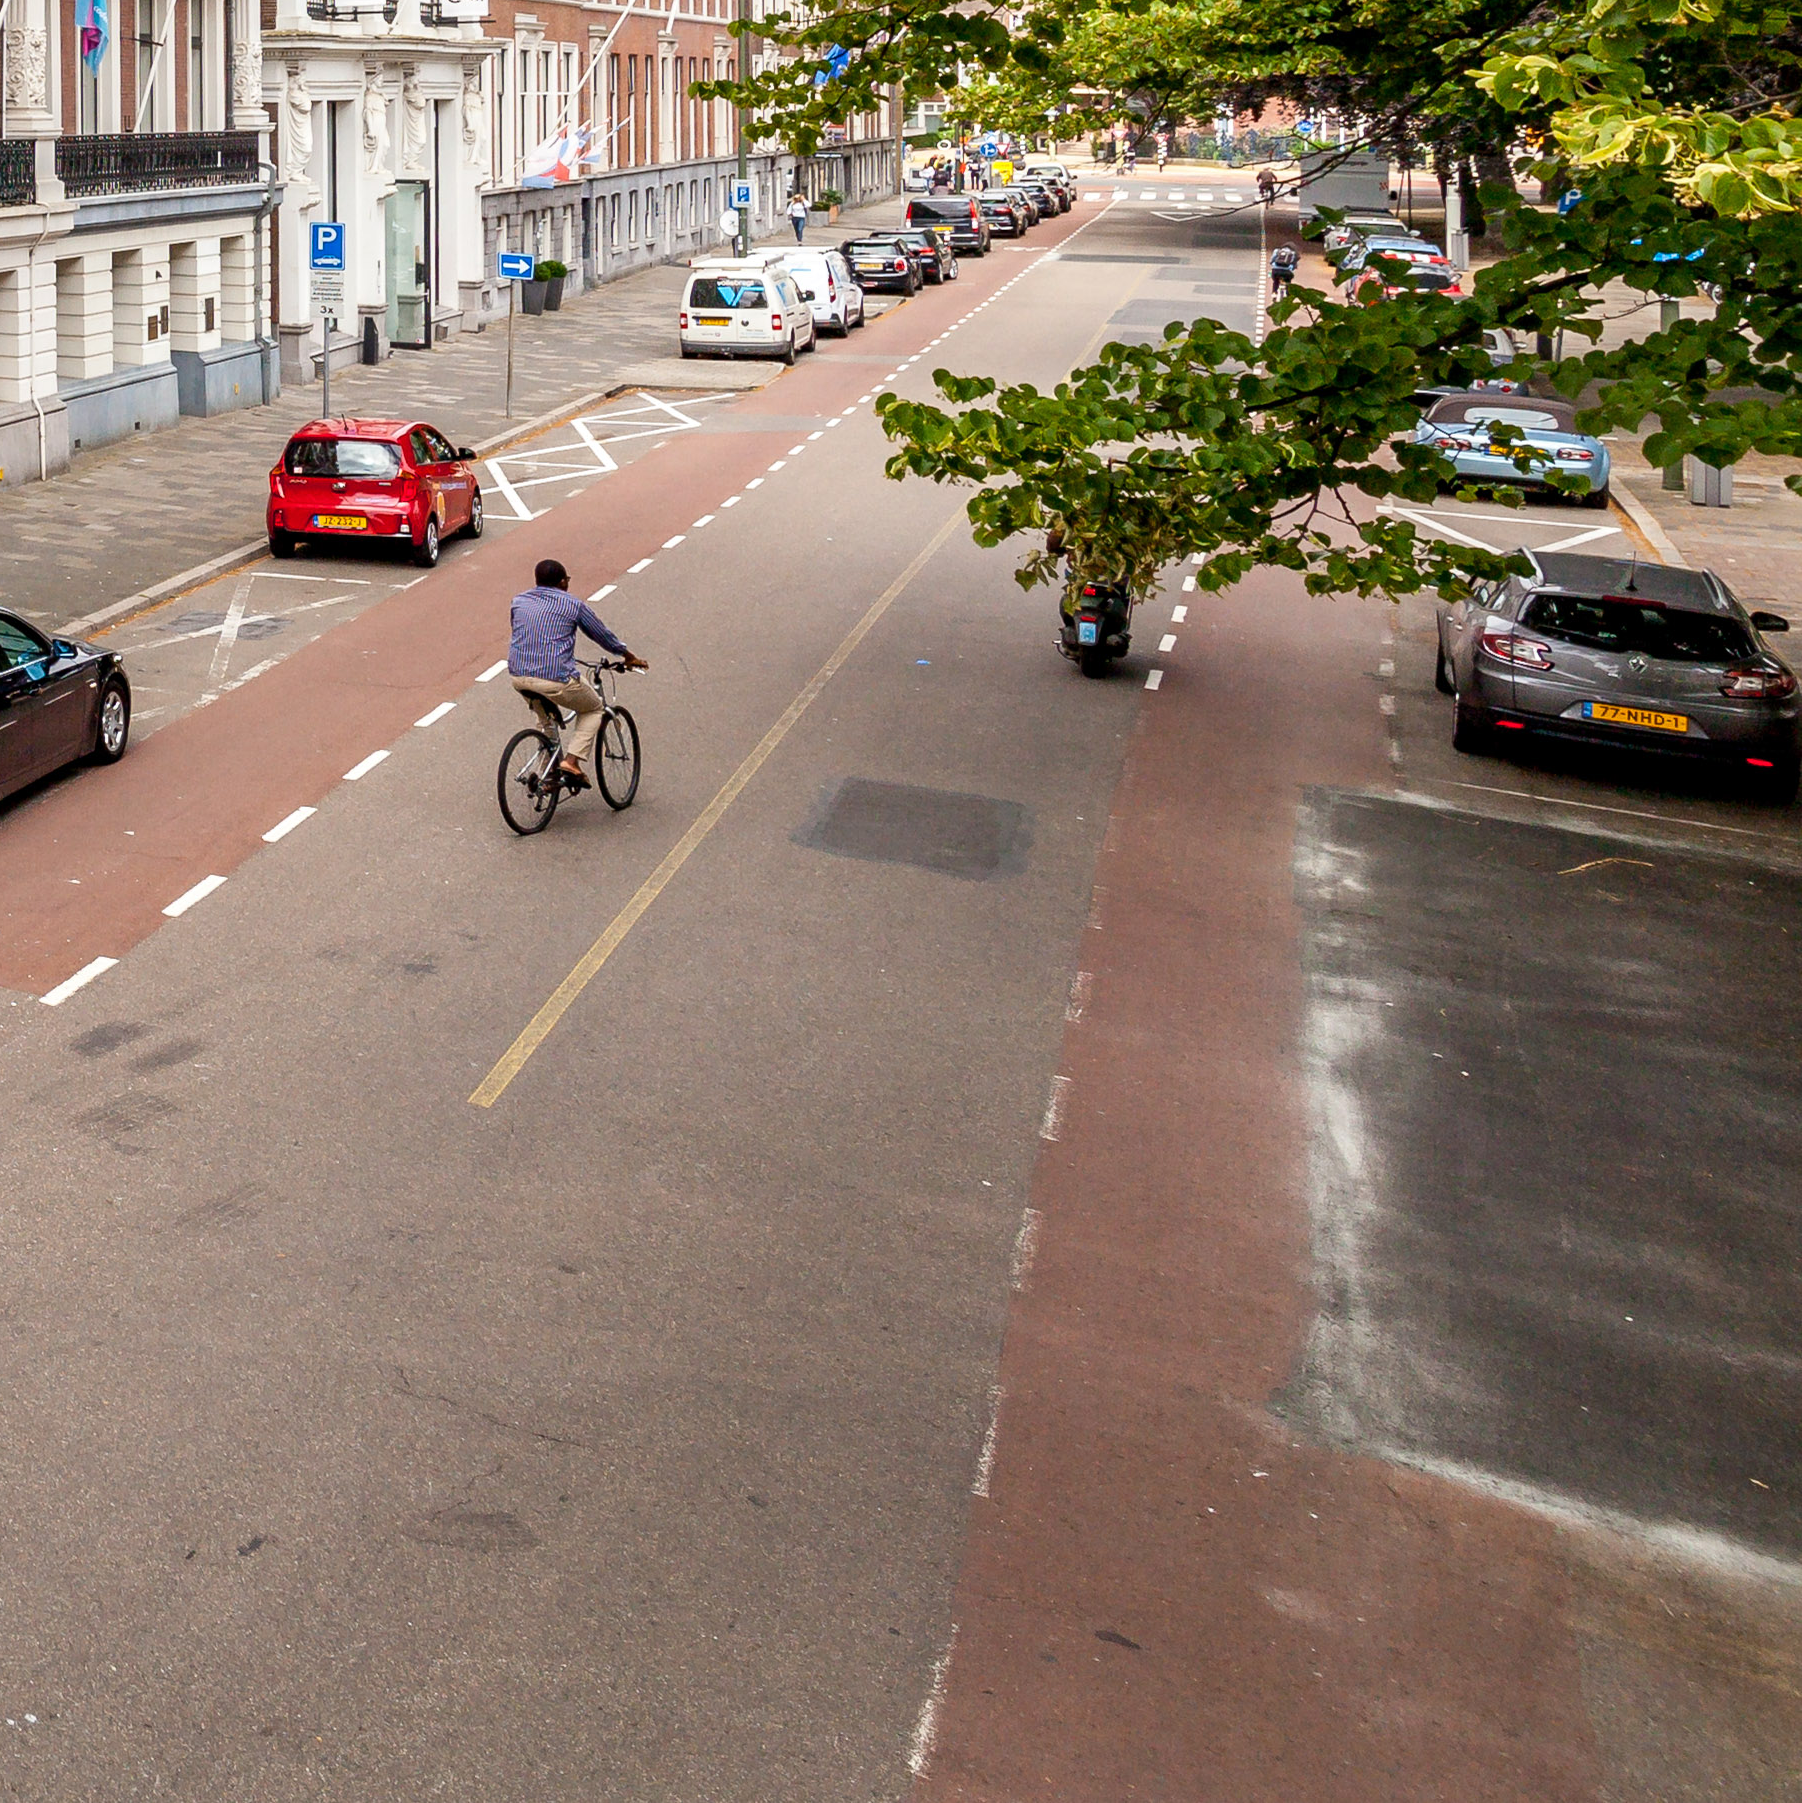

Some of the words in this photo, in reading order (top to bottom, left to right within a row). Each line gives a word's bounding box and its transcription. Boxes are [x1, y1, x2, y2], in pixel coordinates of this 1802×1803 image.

[318, 227, 337, 250] P
[320, 305, 334, 314] 3x
[1598, 706, 1679, 728] 77-NHD-1
